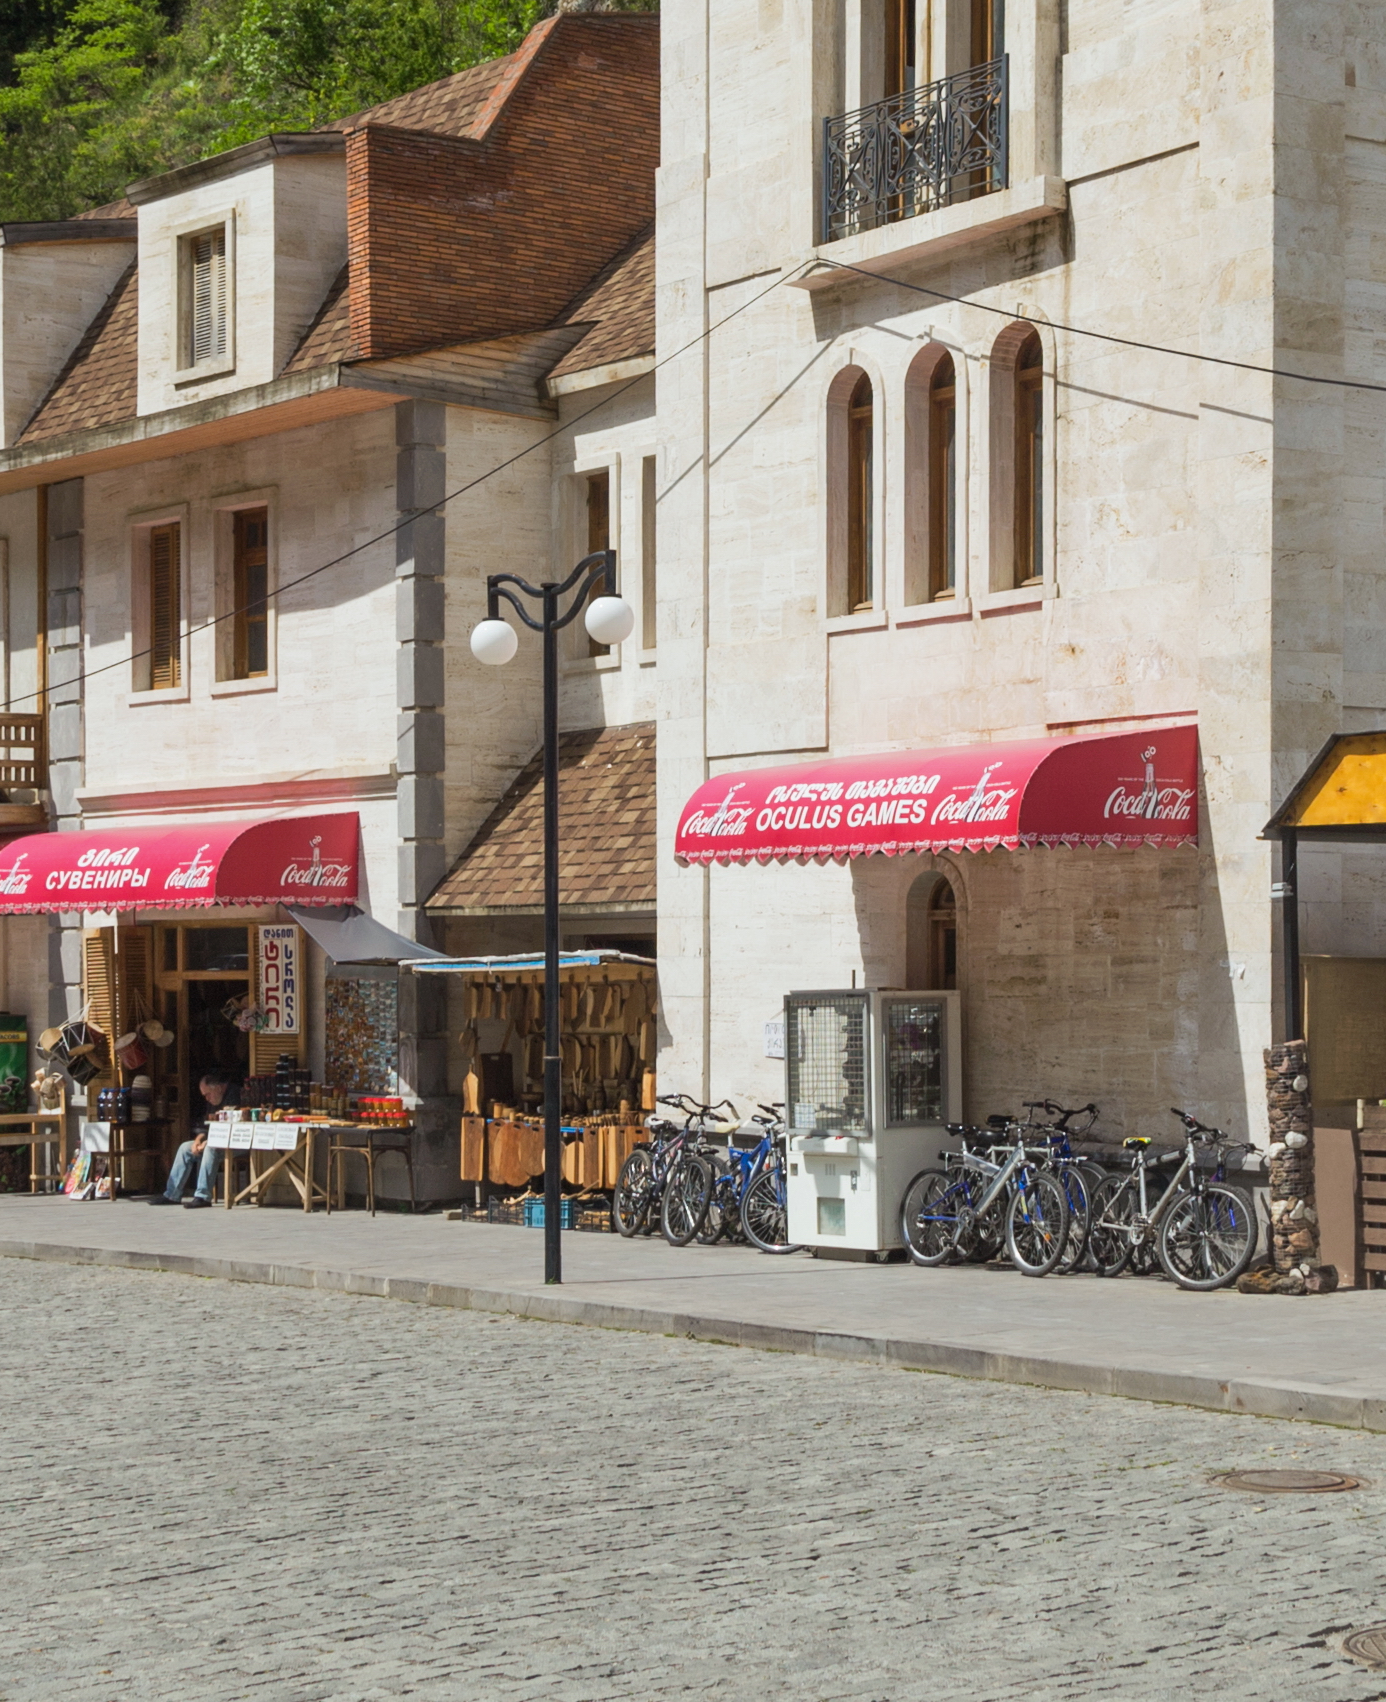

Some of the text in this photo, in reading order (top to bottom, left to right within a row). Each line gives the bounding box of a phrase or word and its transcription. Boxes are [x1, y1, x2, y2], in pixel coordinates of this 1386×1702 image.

[765, 782, 845, 804] ოკულუს
[844, 774, 941, 800] თამაშები
[755, 798, 928, 832] OCULUS GAMES
[45, 867, 151, 890] СУВЕНИРЫ
